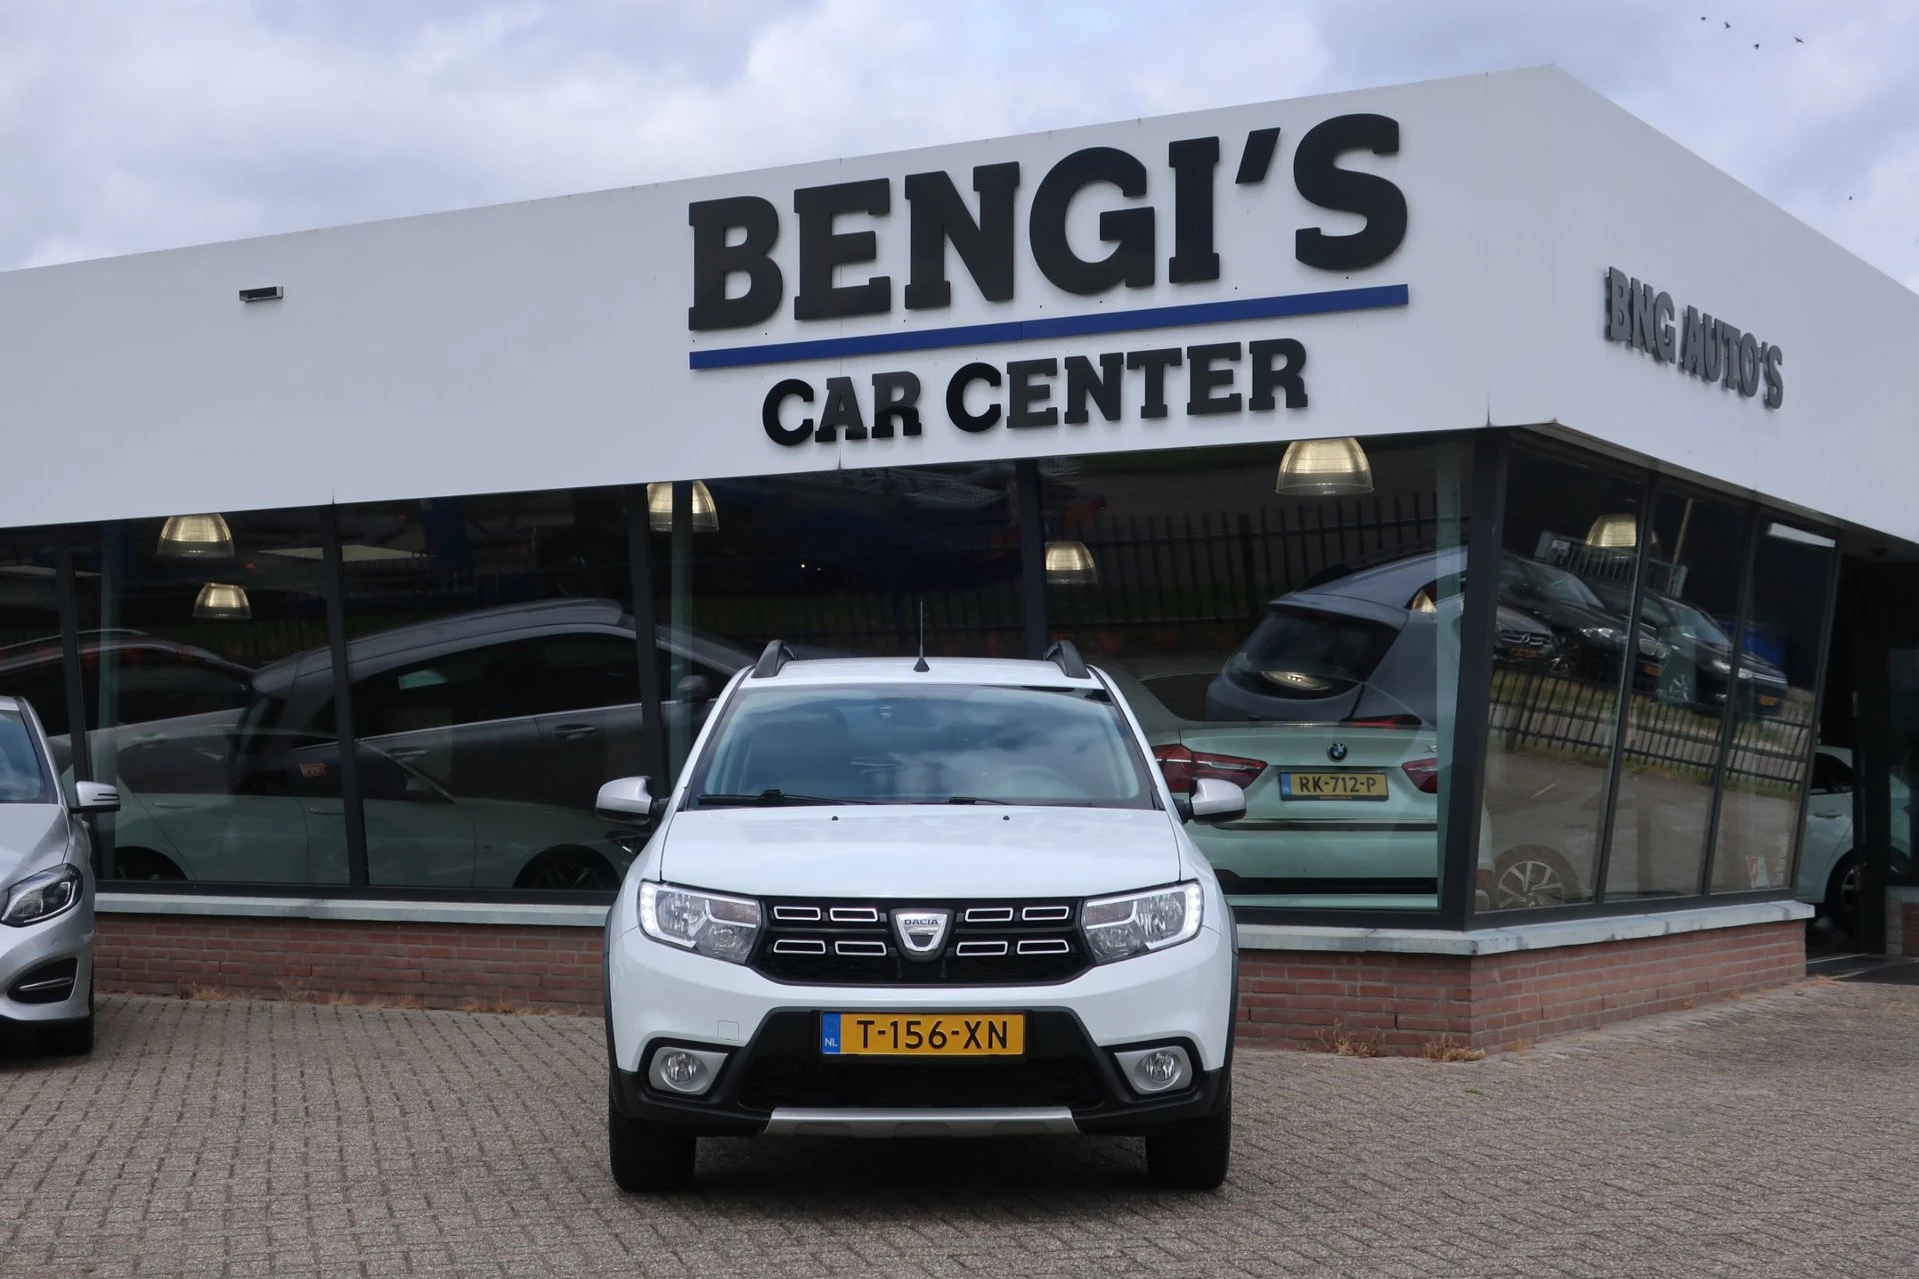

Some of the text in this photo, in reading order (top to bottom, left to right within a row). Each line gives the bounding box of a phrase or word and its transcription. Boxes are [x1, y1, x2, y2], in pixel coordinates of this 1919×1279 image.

[689, 113, 1408, 331] BENGI'S
[1605, 266, 1783, 409] BNG AUTO'S
[762, 337, 1308, 446] CAR CENTER
[1299, 776, 1376, 793] RK-712-P
[824, 1038, 838, 1047] NL
[857, 1020, 1008, 1049] T-156-XN
